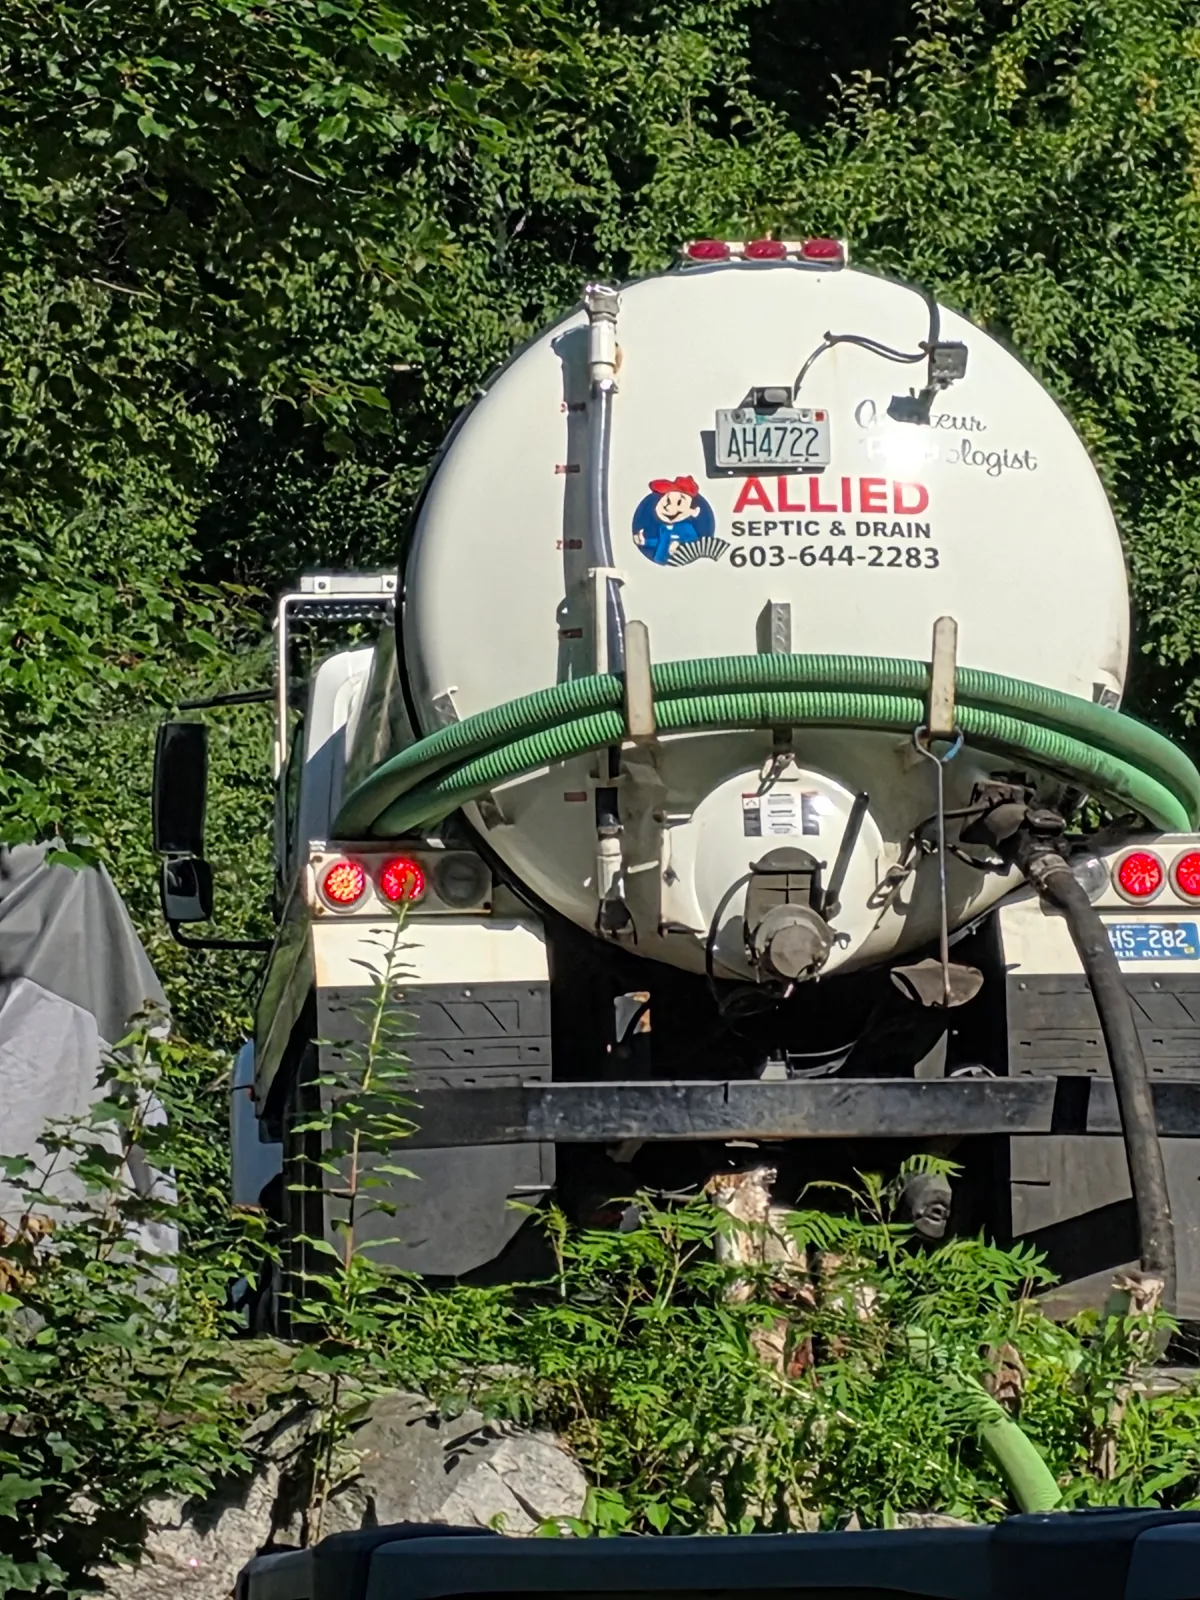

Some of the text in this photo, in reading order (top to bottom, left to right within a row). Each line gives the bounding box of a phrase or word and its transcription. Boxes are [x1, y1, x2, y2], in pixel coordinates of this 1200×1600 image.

[728, 427, 819, 458] AH4722
[732, 475, 930, 515] ALLIED
[731, 521, 931, 538] SEPTIC & DRAIN
[729, 545, 940, 569] 603-644-2283
